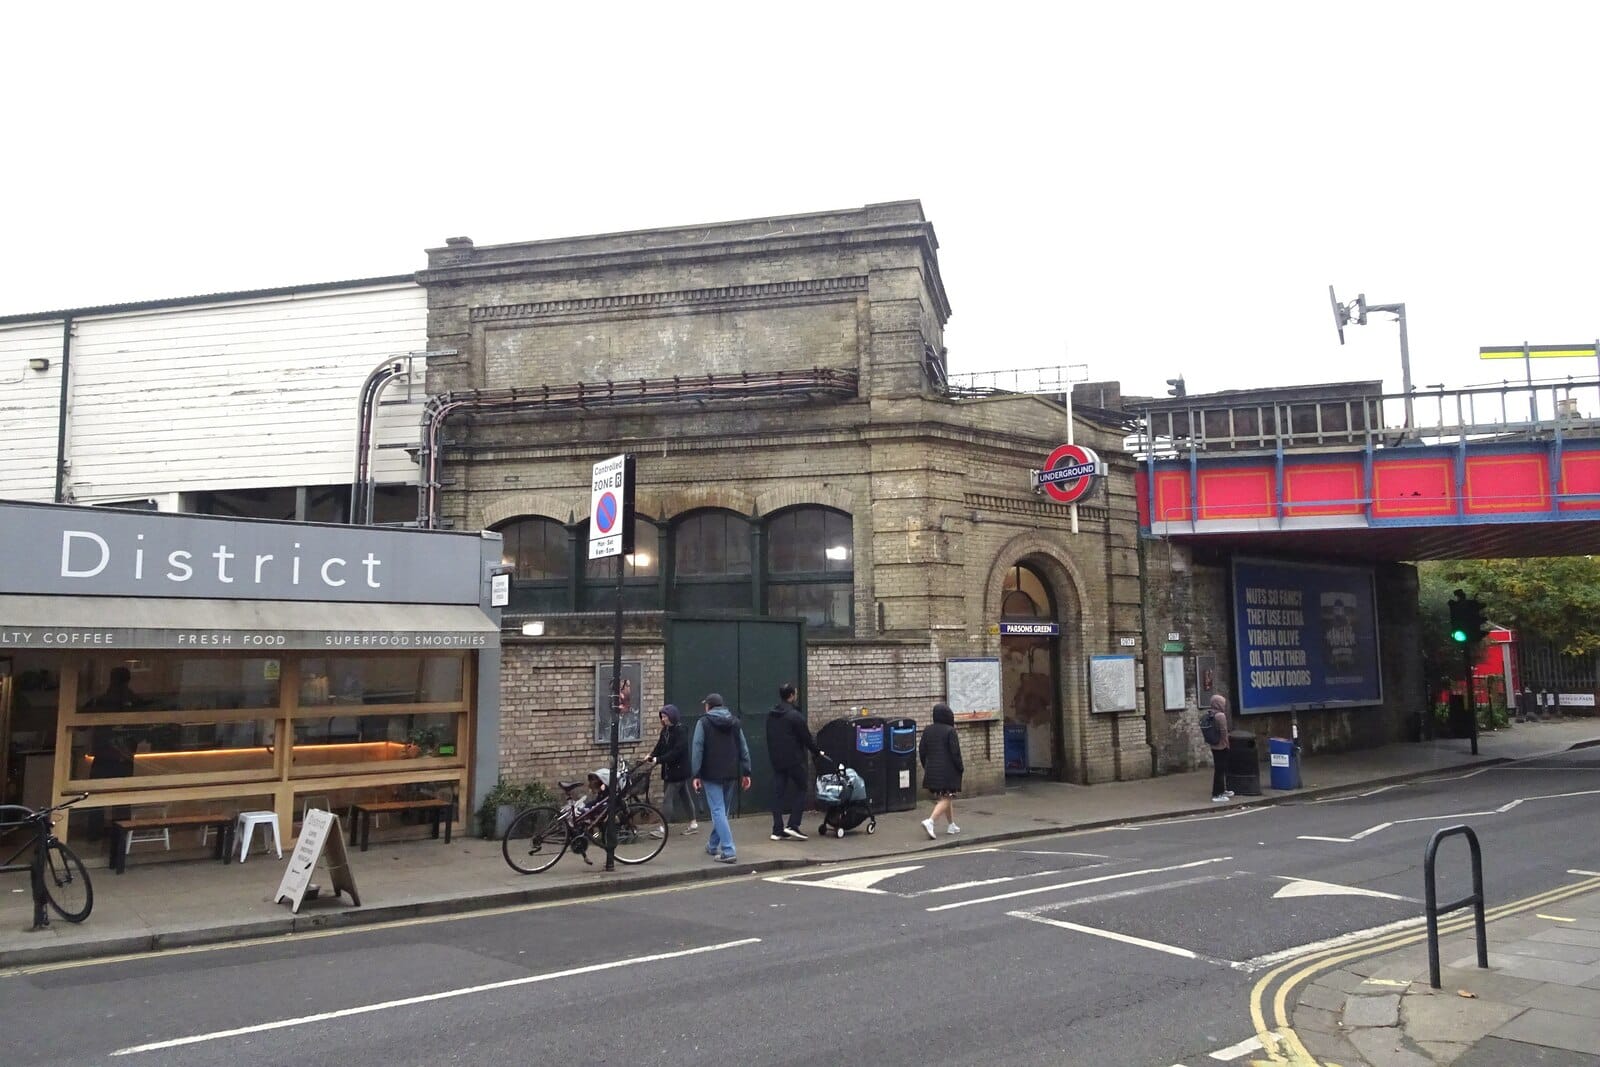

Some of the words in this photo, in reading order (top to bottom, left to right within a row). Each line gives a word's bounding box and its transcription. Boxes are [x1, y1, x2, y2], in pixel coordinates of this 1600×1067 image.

[594, 461, 623, 476] Controlled
[1040, 464, 1095, 482] UNDERGROUND
[593, 477, 613, 492] ZONE
[60, 530, 382, 588] District
[1246, 588, 1267, 605] NUTS
[1268, 590, 1279, 605] SO
[1280, 590, 1303, 606] FANCY
[1247, 608, 1265, 625] THEY
[1266, 609, 1280, 625] USE
[1281, 610, 1304, 625] EXTRA
[1007, 625, 1033, 633] PARSONS
[1033, 625, 1052, 633] GREEN
[1248, 629, 1277, 646] VIRGIN
[1278, 629, 1300, 646] OLIVE
[2, 632, 33, 643] LTY
[43, 632, 114, 644] COFFEE
[178, 634, 232, 645] FRESH
[243, 635, 286, 645] FOOD
[325, 635, 410, 646] SUPERFOOD
[415, 635, 486, 646] SMOOTHIES
[1249, 650, 1262, 667] OIL
[1262, 650, 1273, 667] TO
[1273, 650, 1285, 666] FIX
[1285, 650, 1307, 666] THEIR
[1250, 670, 1286, 689] SQUEAKY
[1286, 670, 1312, 687] DOORS
